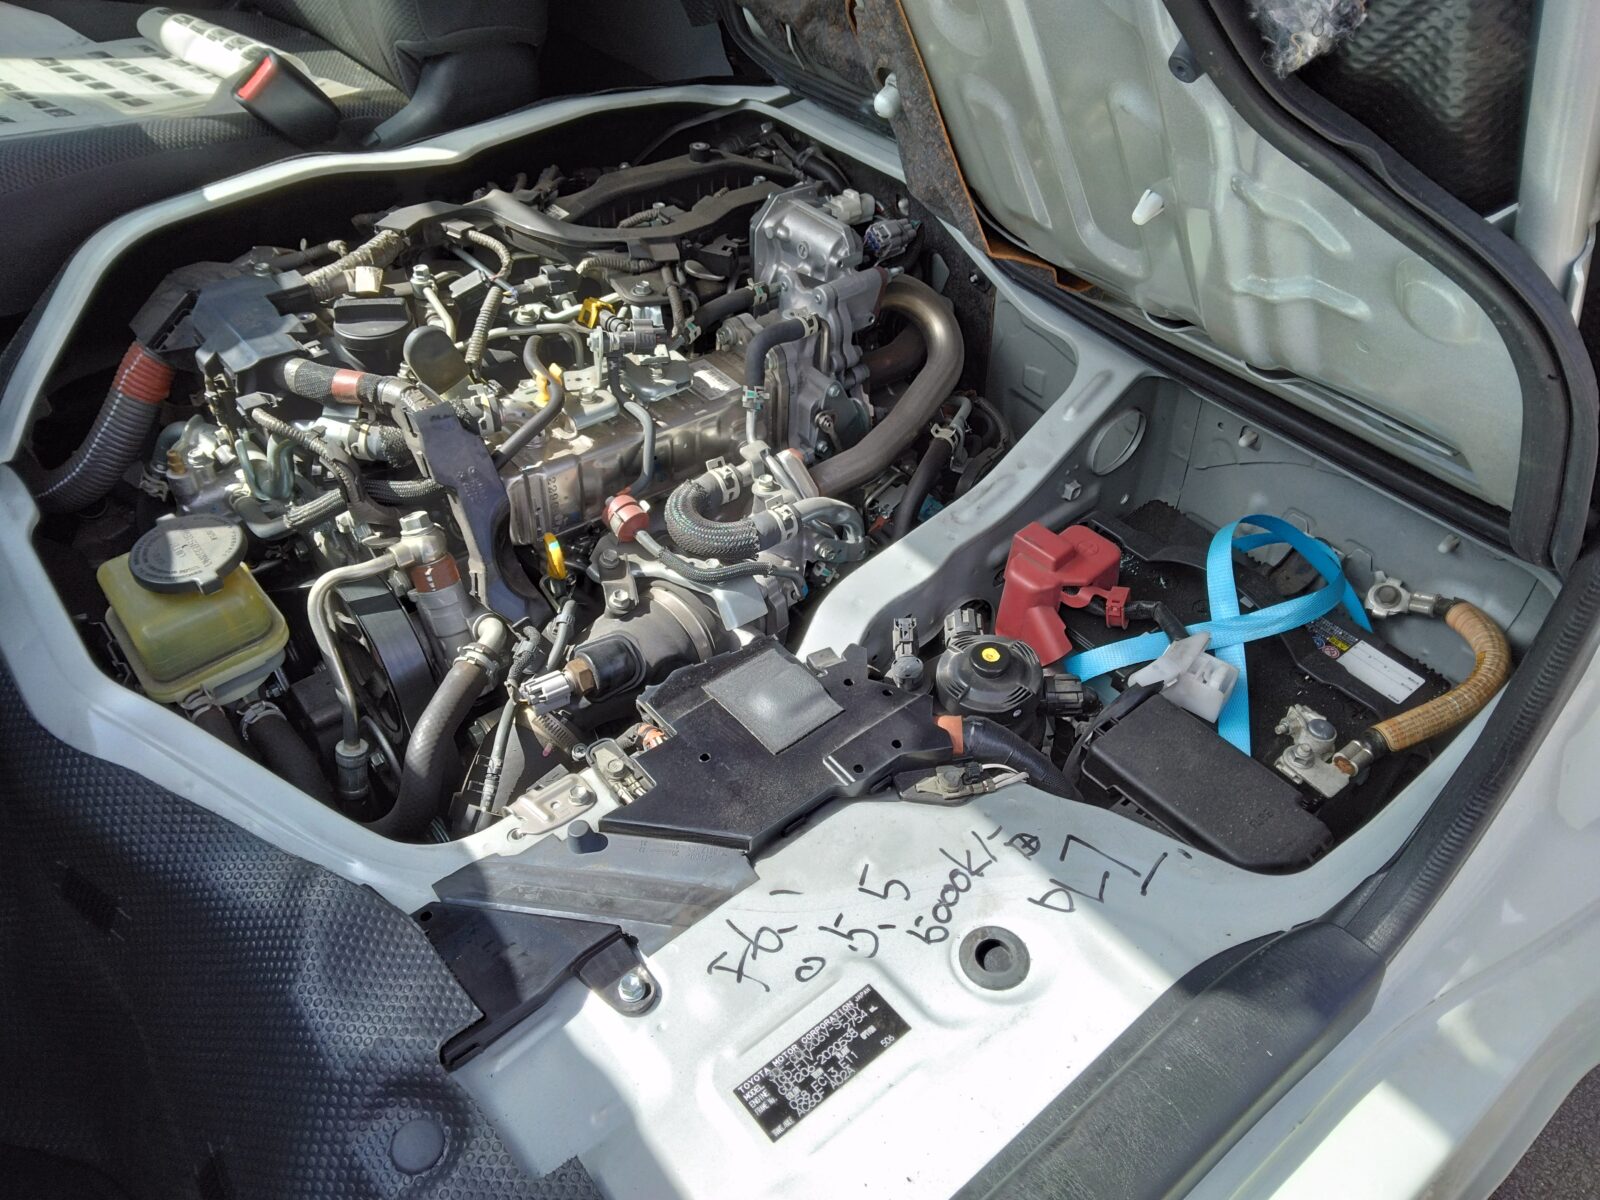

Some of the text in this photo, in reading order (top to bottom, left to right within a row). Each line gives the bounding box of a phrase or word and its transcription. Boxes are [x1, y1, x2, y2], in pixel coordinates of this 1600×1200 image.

[737, 986, 871, 1094] TOYOTA MOTOR CORPORATION JAPAN
[747, 1088, 770, 1109] ENGINE
[841, 1008, 869, 1032] 2754
[879, 1032, 895, 1047] 506
